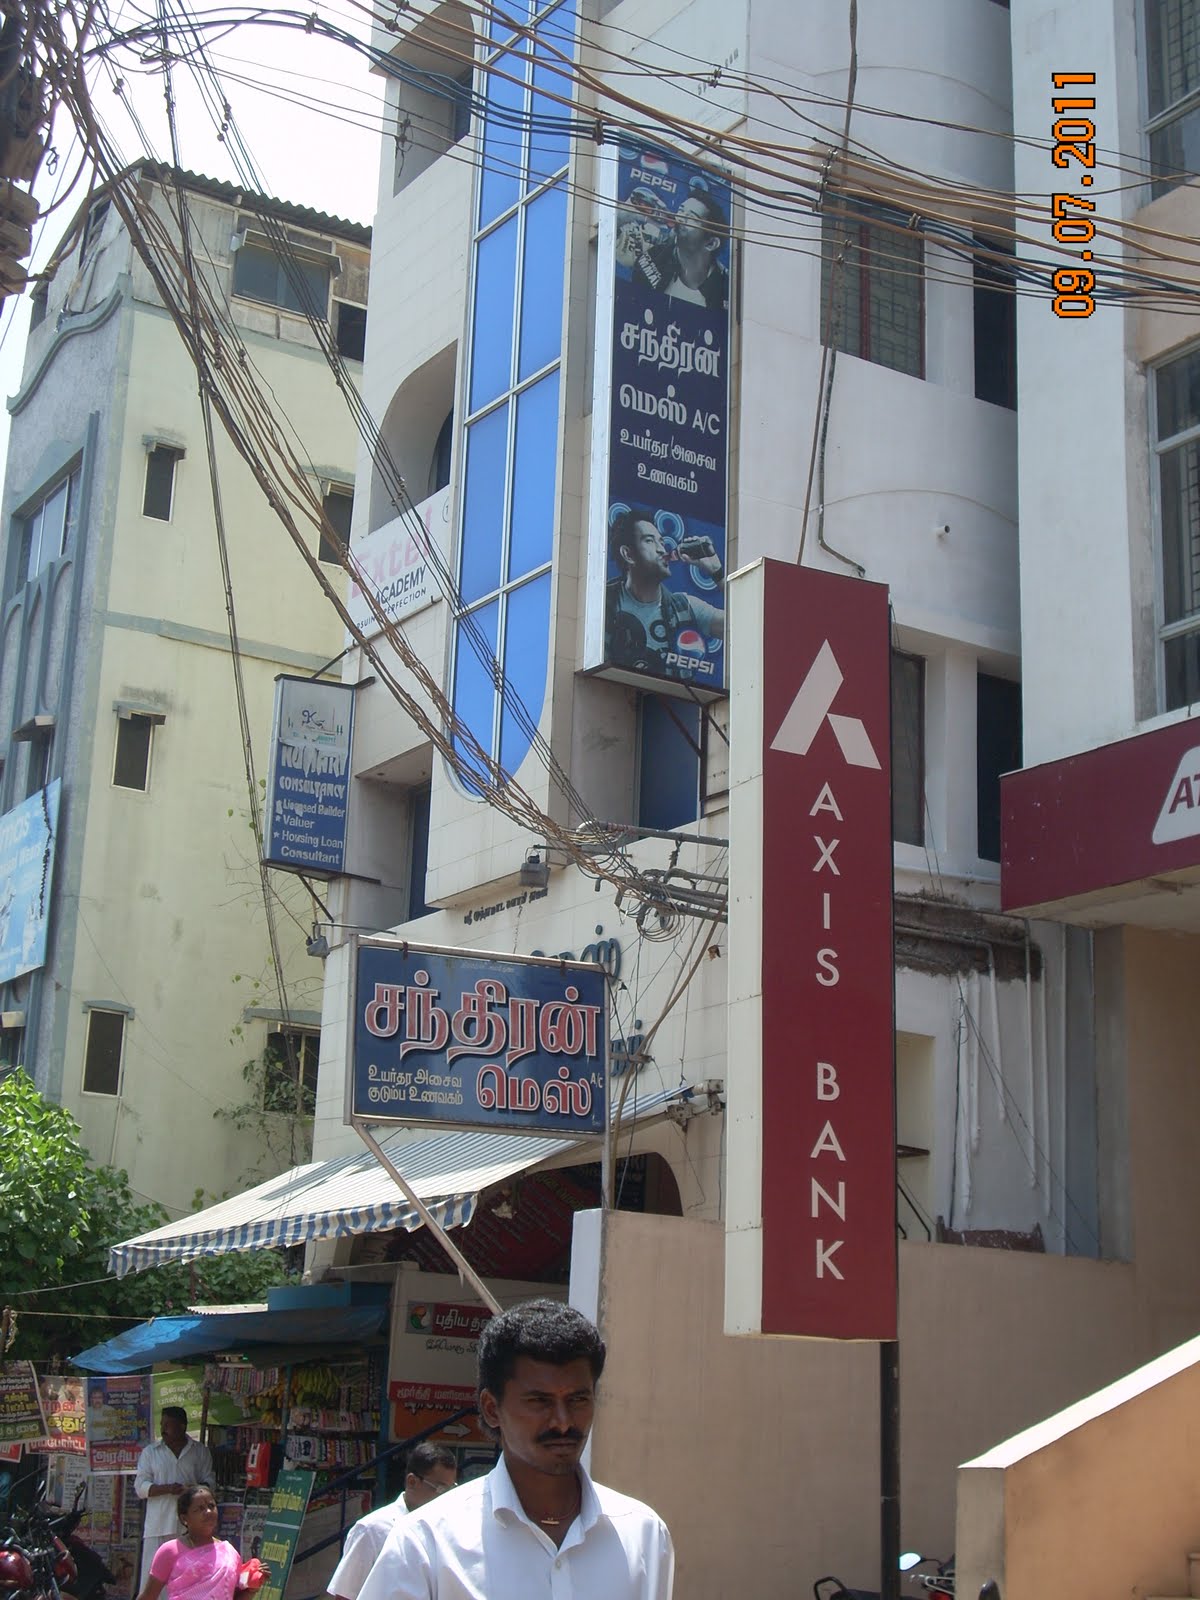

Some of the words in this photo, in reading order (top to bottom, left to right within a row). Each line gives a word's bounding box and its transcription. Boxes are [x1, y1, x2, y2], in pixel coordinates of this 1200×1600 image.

[630, 168, 677, 194] PEPSI
[620, 308, 721, 378] சந்திரன்
[619, 384, 687, 426] மெஸ்
[692, 408, 720, 435] A/C
[637, 462, 698, 494] உணவகம்
[665, 653, 715, 675] PEPSI
[283, 814, 315, 829] Valuer
[281, 846, 340, 865] Consultant
[282, 830, 319, 849] Housing
[320, 835, 344, 850] Loan
[808, 781, 845, 988] AXIS
[364, 969, 601, 1068] சந்திரன்
[409, 1085, 464, 1106] உணவகம்
[414, 1068, 462, 1088] அசைவ
[476, 1063, 593, 1116] மெஸ்
[809, 1061, 847, 1281] BANK
